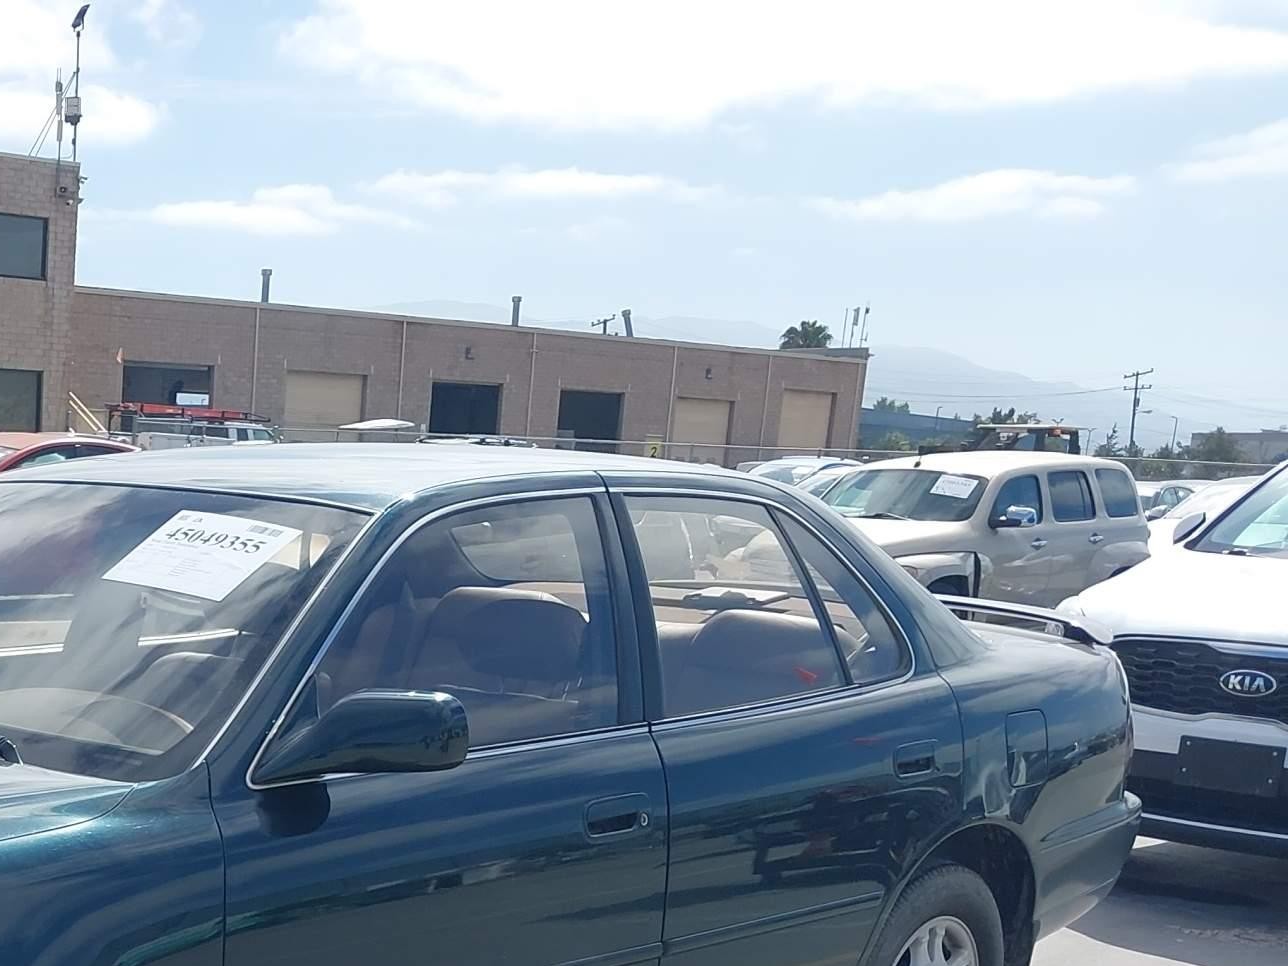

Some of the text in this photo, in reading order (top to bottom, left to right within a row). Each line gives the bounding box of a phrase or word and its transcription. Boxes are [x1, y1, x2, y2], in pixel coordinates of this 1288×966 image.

[650, 446, 657, 458] 2
[166, 527, 268, 553] 45049355
[1228, 674, 1266, 692] KIA
